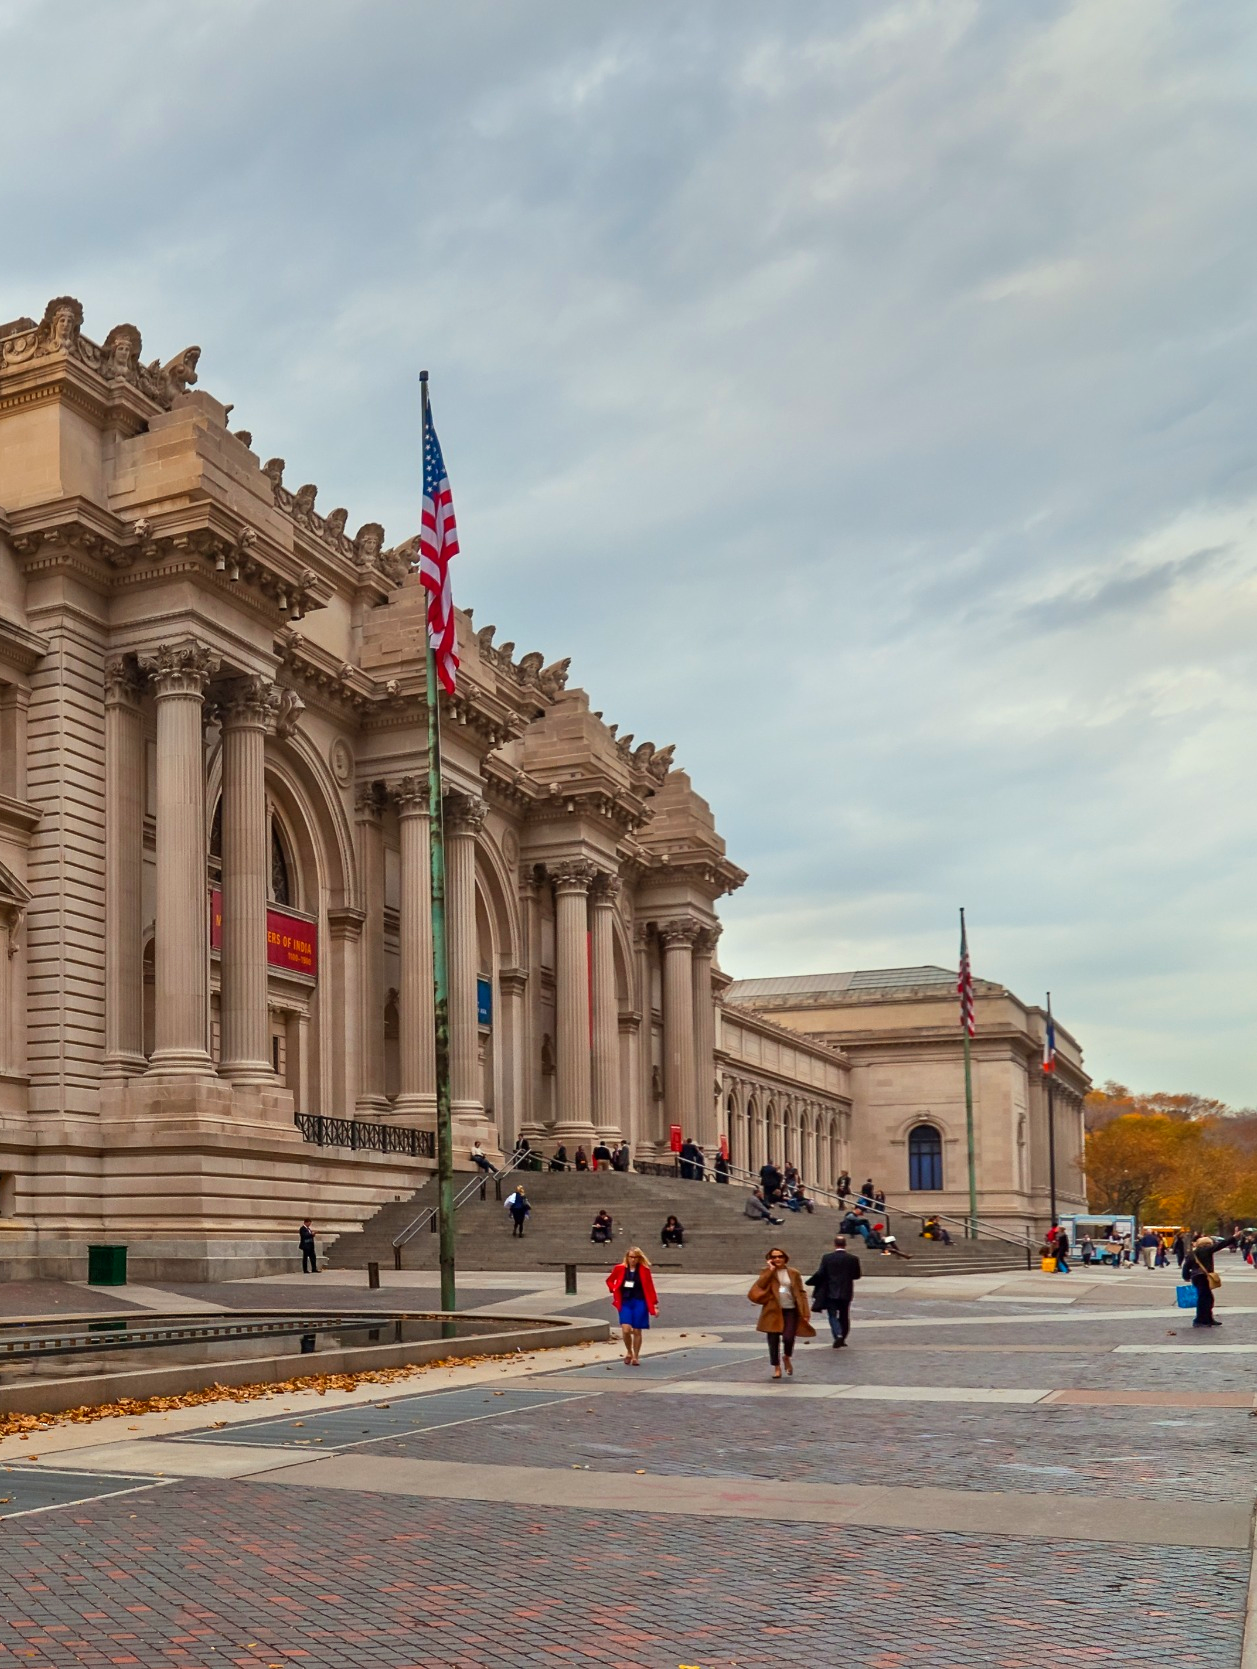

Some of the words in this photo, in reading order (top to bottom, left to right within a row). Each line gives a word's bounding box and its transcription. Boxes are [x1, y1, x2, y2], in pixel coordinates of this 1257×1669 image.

[266, 931, 281, 945] ERS
[283, 936, 292, 948] OF
[294, 939, 312, 954] INDIA
